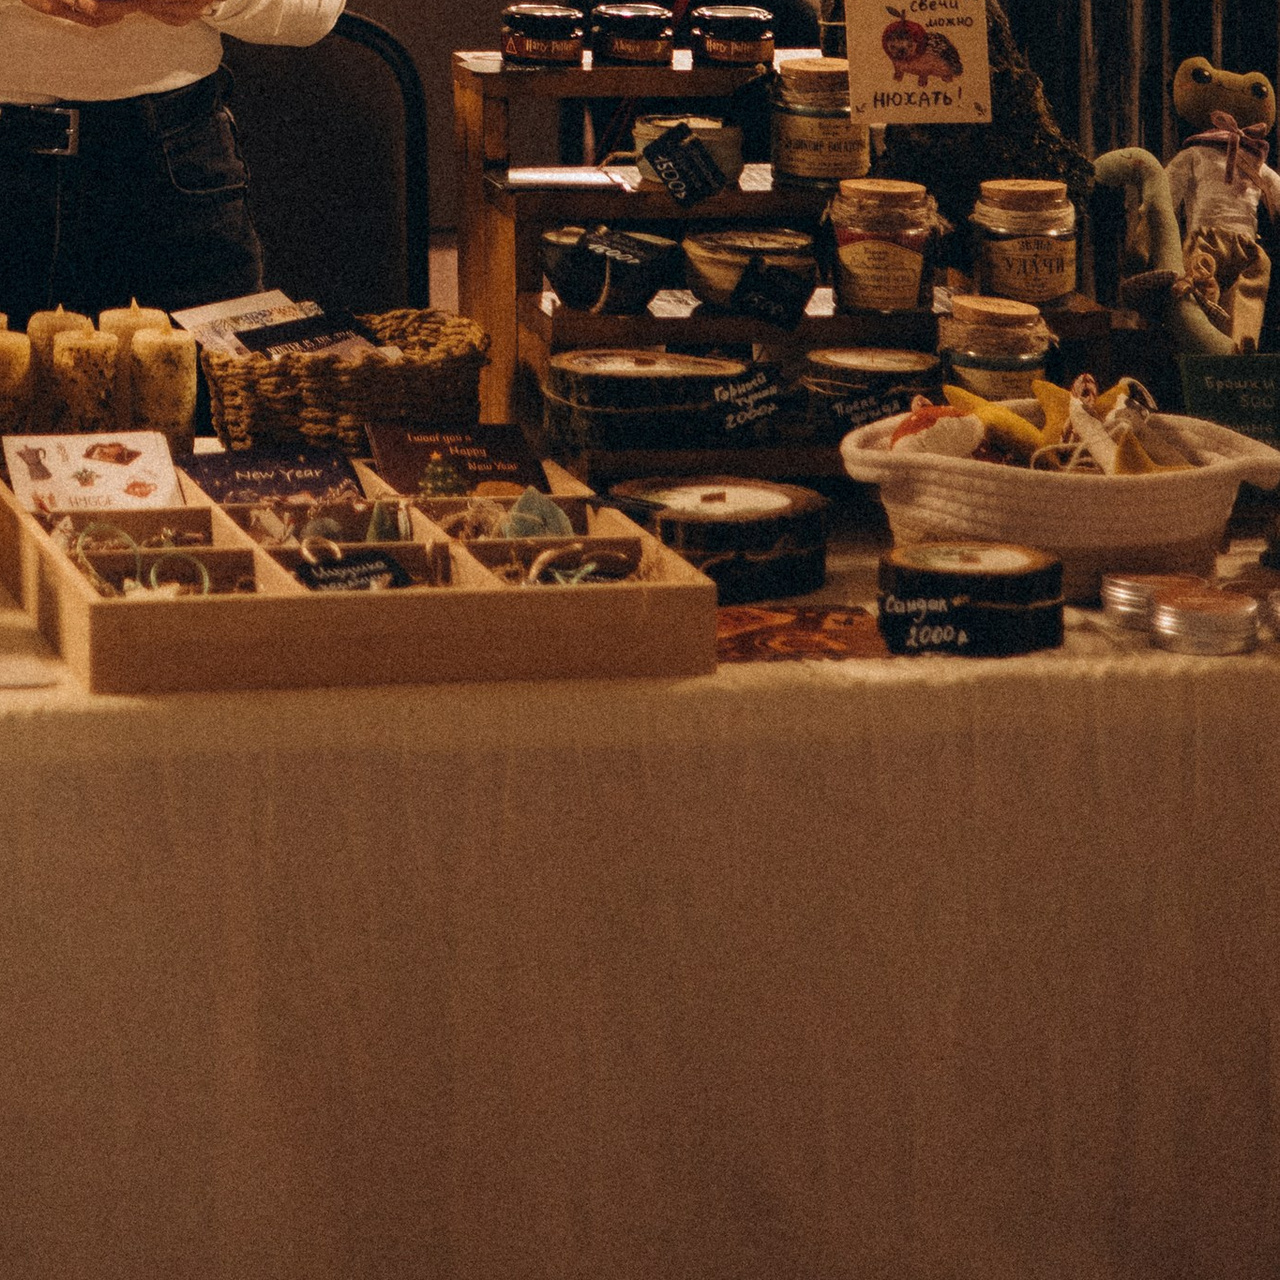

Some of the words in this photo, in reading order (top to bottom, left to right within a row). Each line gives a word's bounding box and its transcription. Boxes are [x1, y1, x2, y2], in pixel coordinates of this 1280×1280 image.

[925, 15, 974, 28] можно
[525, 39, 548, 53] Harry
[705, 38, 728, 53] Harry
[873, 86, 963, 109] НЮХАТЬ!
[1005, 256, 1065, 276] УДАЧИ
[448, 445, 487, 458] Happy
[467, 461, 492, 471] New
[494, 461, 518, 471] Year
[235, 469, 276, 482] New
[277, 467, 324, 483] Year
